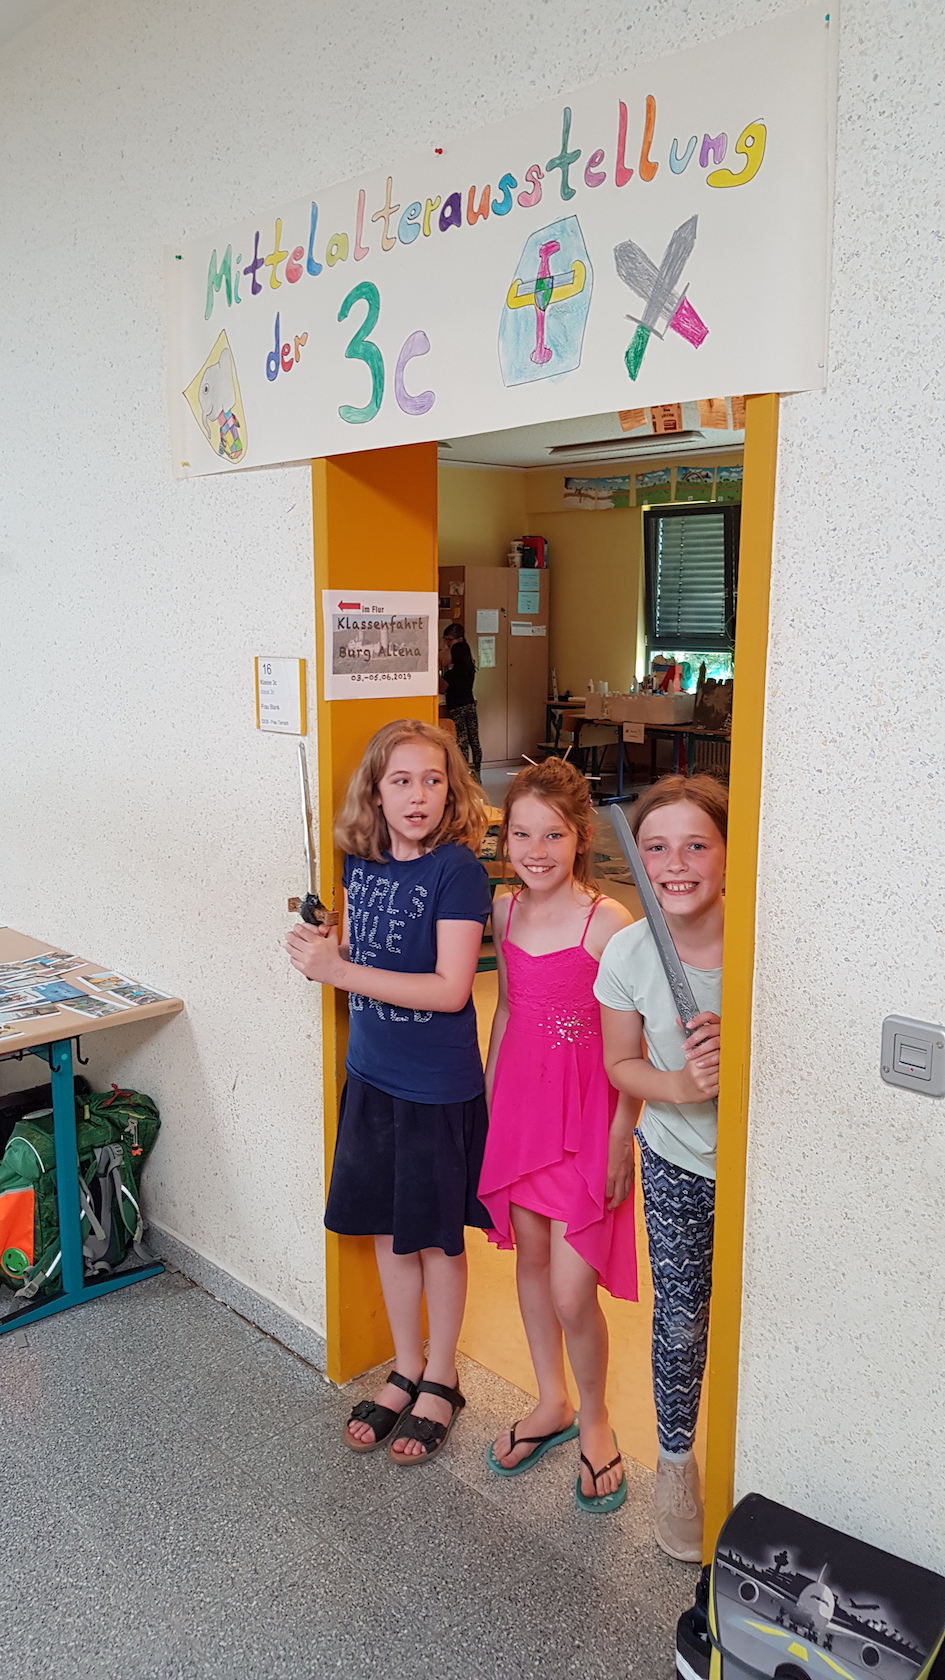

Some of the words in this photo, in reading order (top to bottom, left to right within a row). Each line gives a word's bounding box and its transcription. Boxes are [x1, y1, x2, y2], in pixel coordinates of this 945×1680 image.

[204, 94, 768, 320] Mittelalterausstellung
[265, 311, 309, 382] der
[337, 615, 424, 633] Klassenfahrt
[339, 646, 371, 662] Burg
[377, 644, 421, 658] Altena
[263, 664, 271, 675] 16
[351, 673, 411, 681] 03.-05.06.2019
[347, 867, 428, 919] GIRLS
